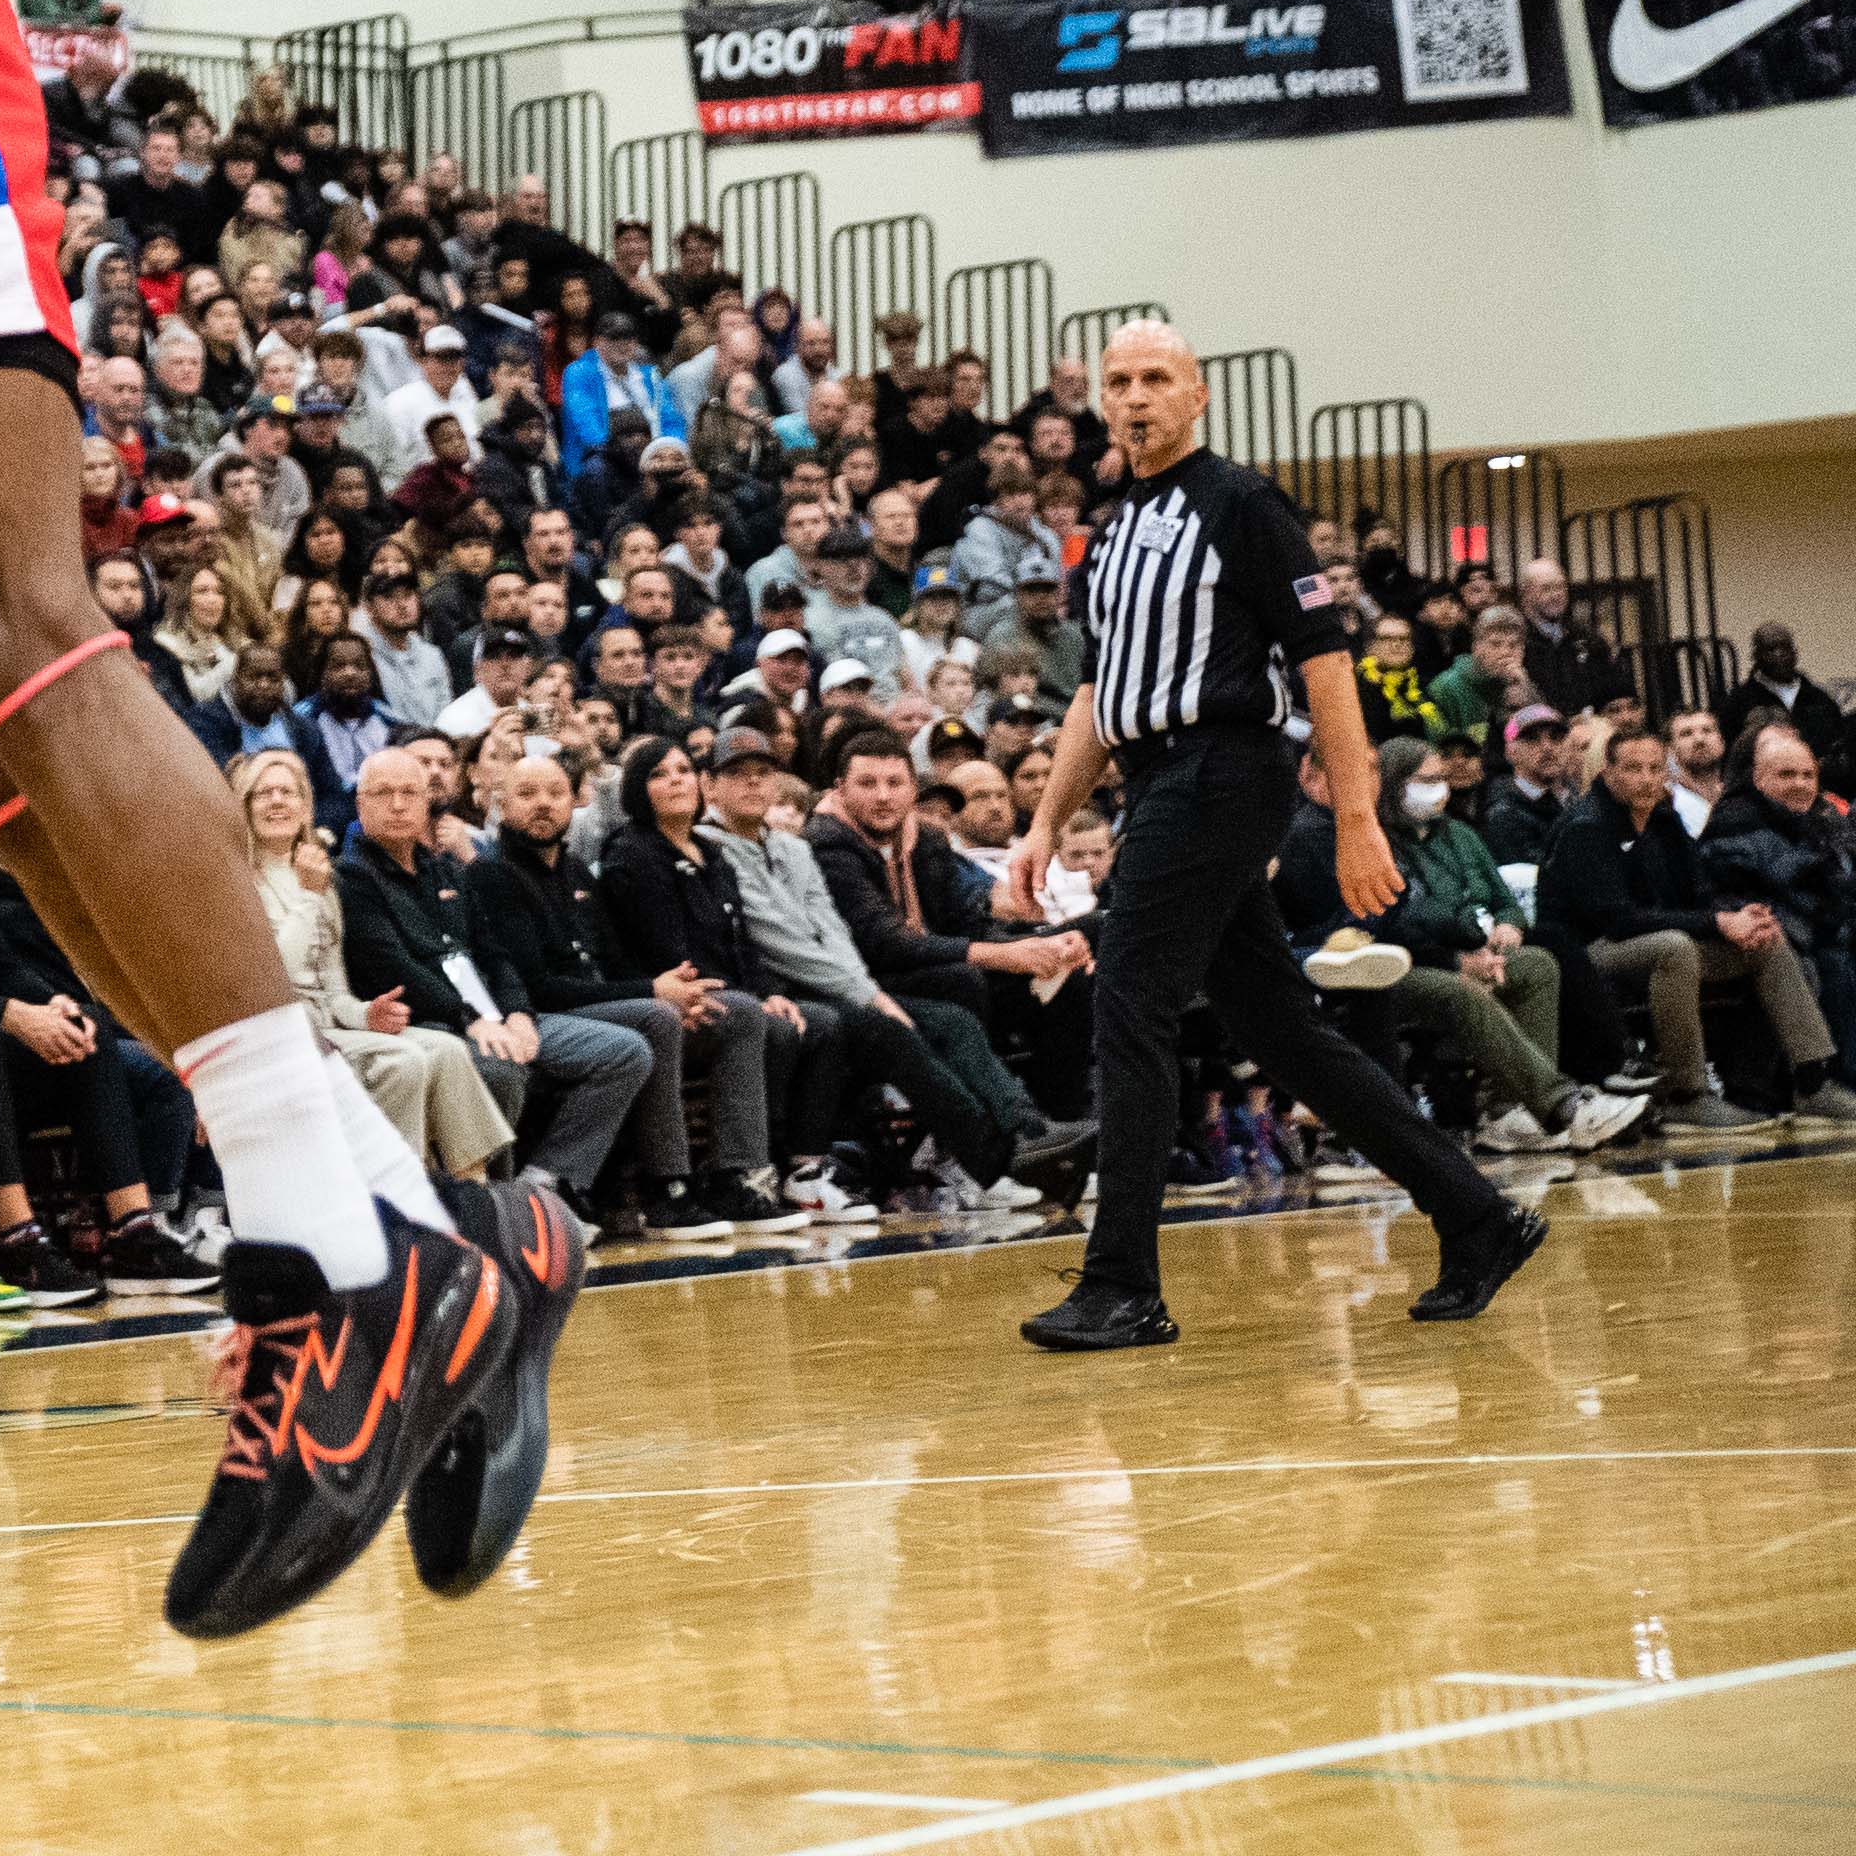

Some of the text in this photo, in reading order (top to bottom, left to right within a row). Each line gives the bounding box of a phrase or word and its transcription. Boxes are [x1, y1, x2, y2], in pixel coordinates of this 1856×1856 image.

[695, 25, 819, 81] 1080
[843, 18, 962, 69] FAN
[1010, 66, 1380, 119] HOME OF HIGH SCHOOL SPORTS
